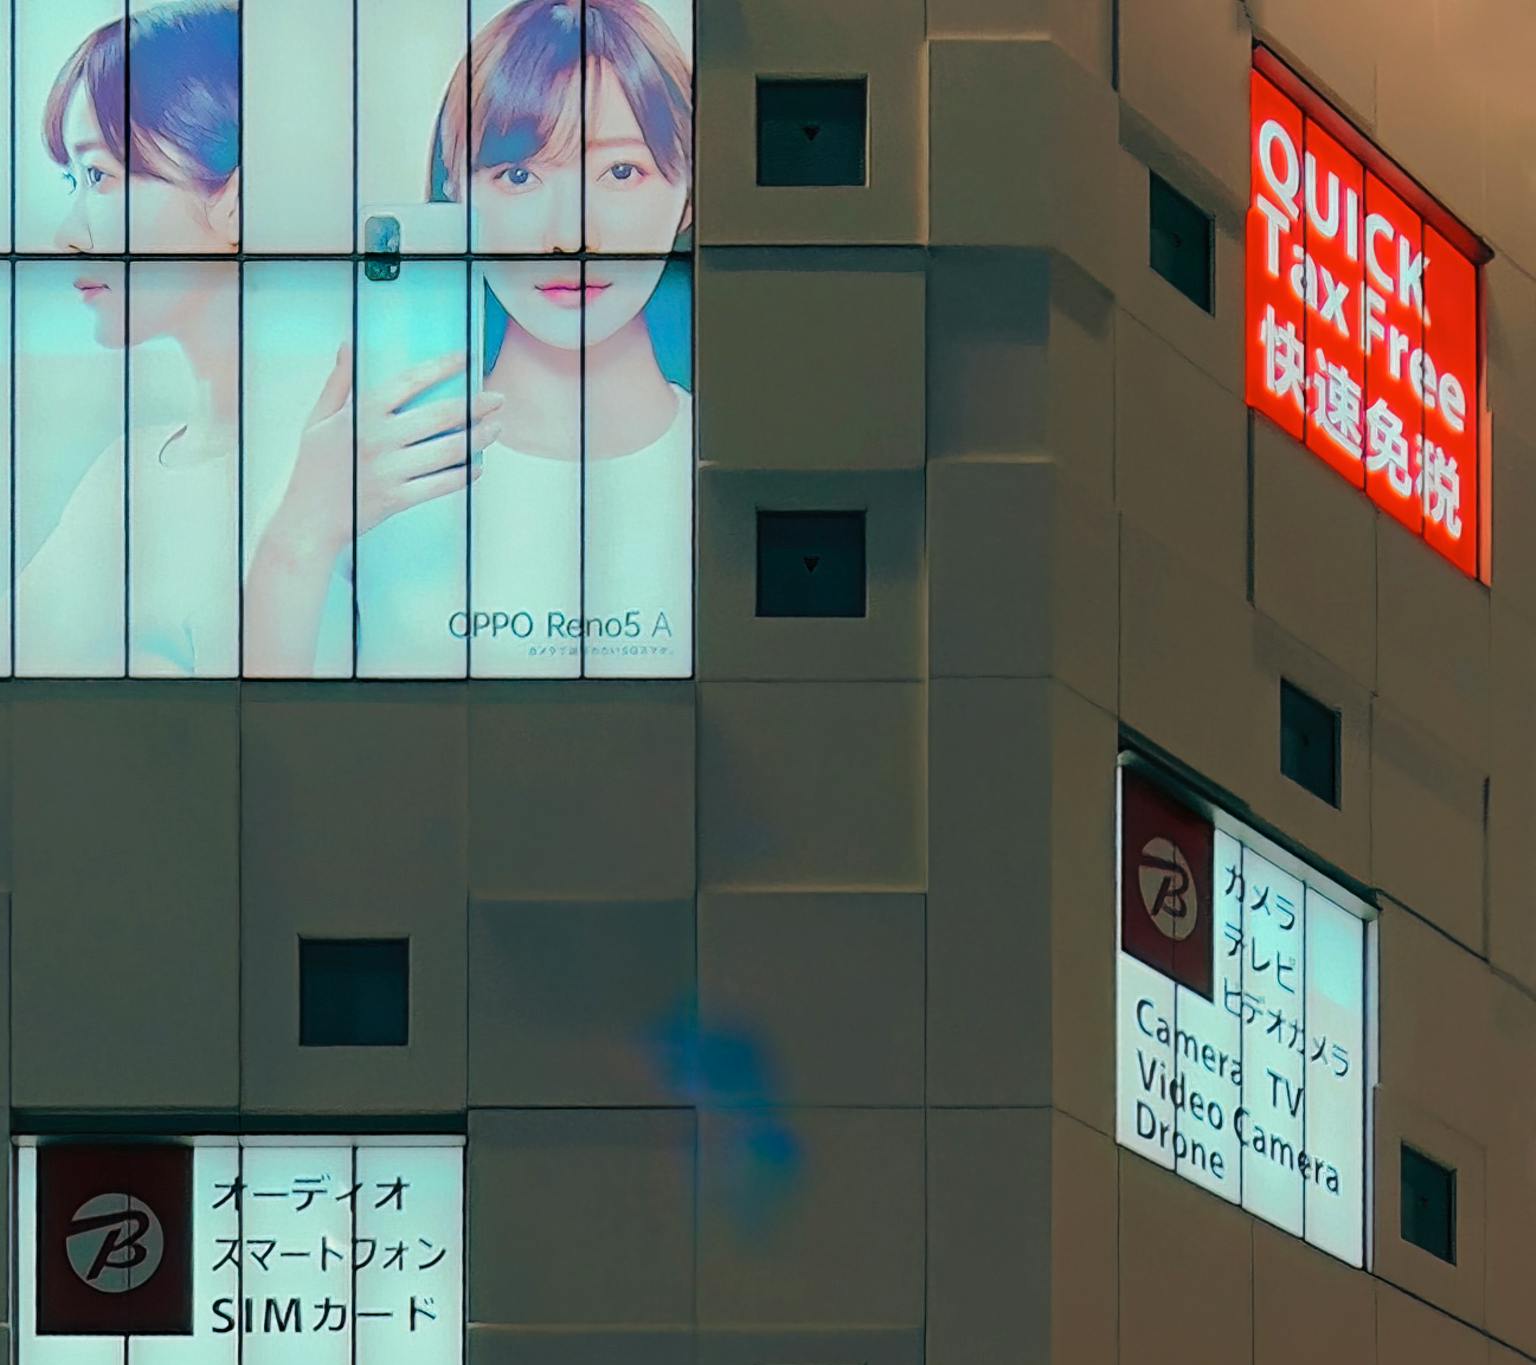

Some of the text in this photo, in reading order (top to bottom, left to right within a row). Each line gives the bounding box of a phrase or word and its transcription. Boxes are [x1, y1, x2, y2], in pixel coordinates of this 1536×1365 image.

[1258, 117, 1431, 327] QUICK
[1257, 194, 1466, 432] Tax Free
[1261, 305, 1462, 538] 快速免税
[449, 611, 672, 638] OPPO Reno5 A
[1225, 865, 1295, 931] カメラ
[1225, 924, 1296, 993] テレビ
[1136, 999, 1304, 1119] Camera TV
[1224, 976, 1350, 1077] ビデオカメラ
[1136, 1050, 1340, 1196] Video Camera
[1136, 1101, 1225, 1179] Drone
[212, 1175, 410, 1212] オーディオ
[212, 1237, 447, 1272] スマートフォン
[212, 1297, 437, 1334] SIMカード
